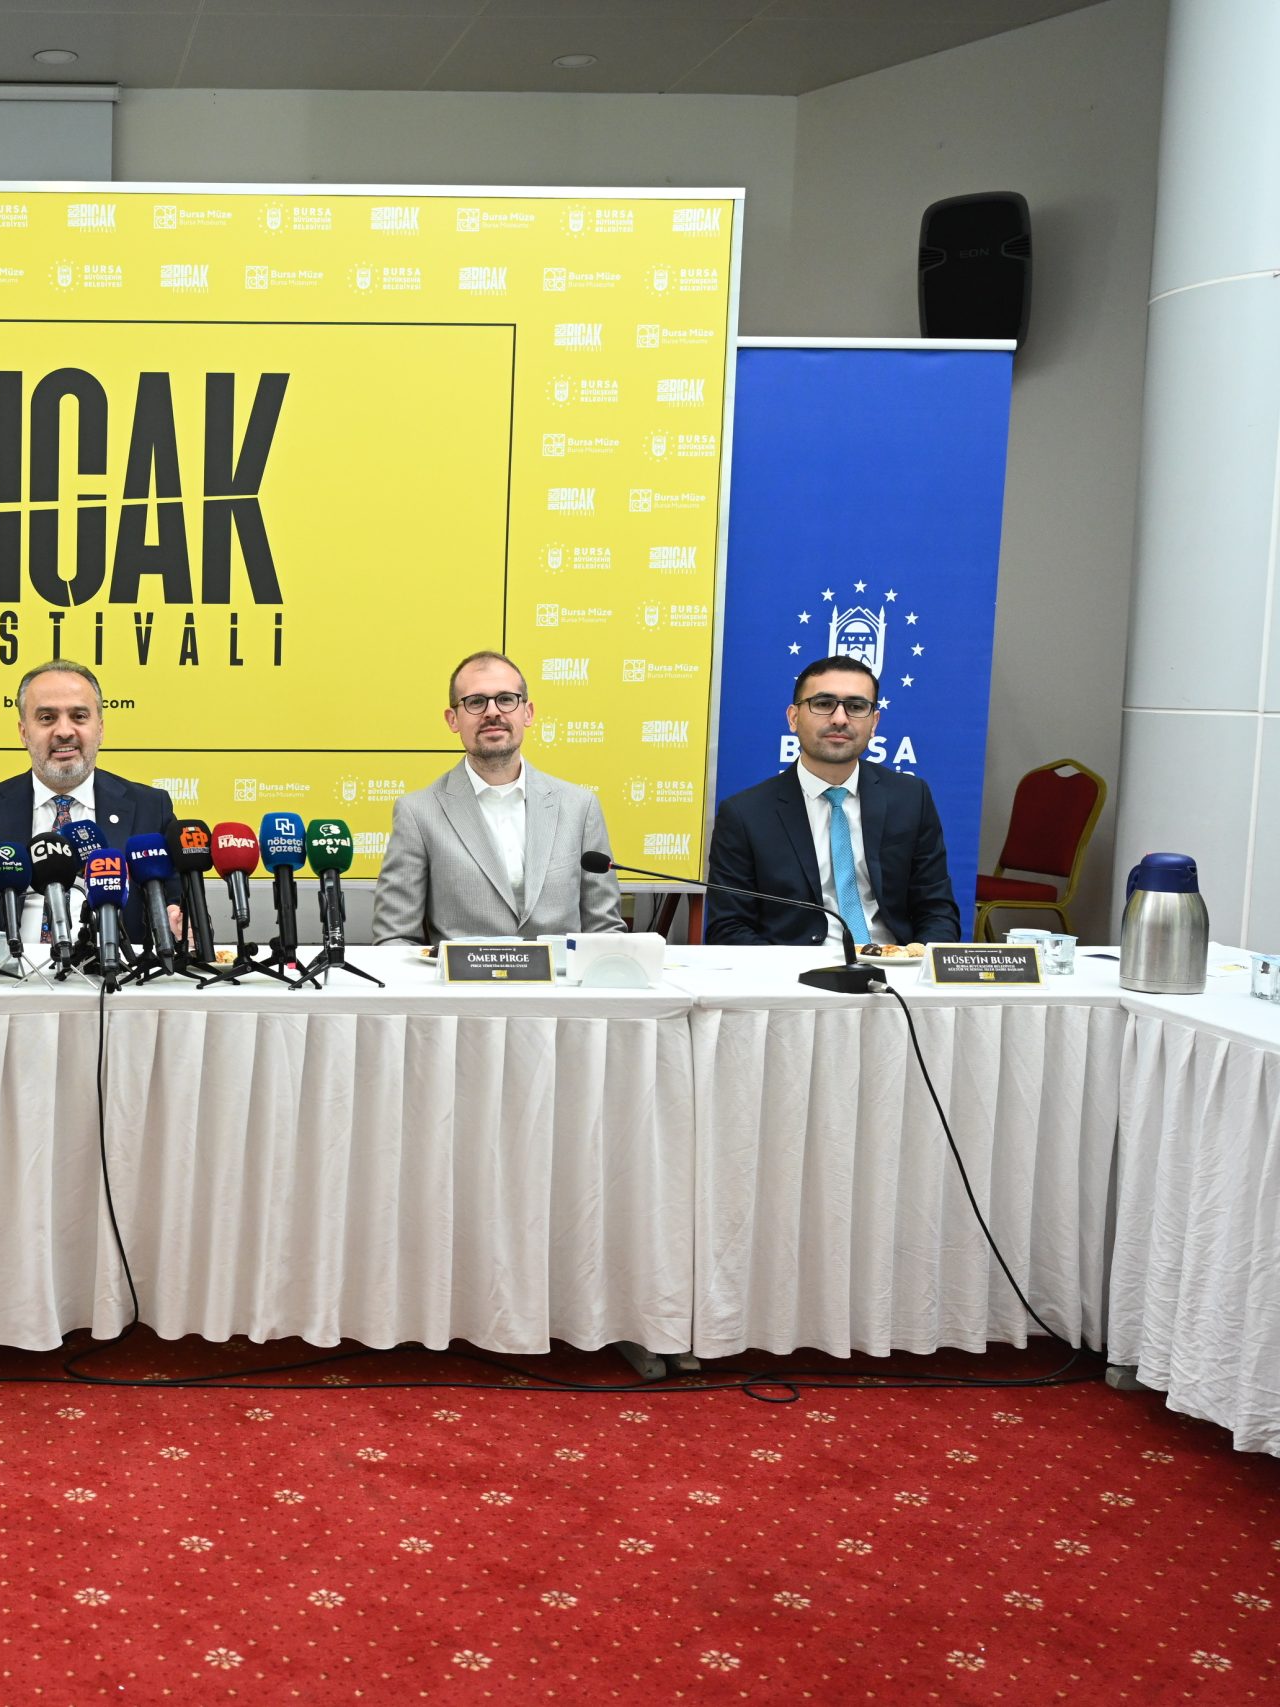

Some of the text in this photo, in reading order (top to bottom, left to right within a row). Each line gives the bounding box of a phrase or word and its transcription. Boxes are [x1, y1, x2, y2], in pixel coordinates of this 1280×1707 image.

[179, 210, 231, 218] Bursa Müze
[294, 208, 332, 216] BURSA
[596, 210, 634, 218] BURSA
[482, 213, 534, 221] Bursa Müze
[0, 267, 26, 276] Müze
[84, 265, 122, 273] BURSA
[383, 268, 420, 276] BURSA
[680, 269, 717, 277] BURSA
[271, 270, 324, 278] Bursa Müze
[568, 272, 620, 280] Bursa Müze
[661, 329, 713, 337] Bursa Müze
[581, 380, 618, 388] BURSA
[567, 438, 619, 446] Bursa Müze
[678, 435, 715, 443] BURSA
[654, 493, 706, 501] Bursa Müze
[561, 608, 613, 616] Bursa Müze
[671, 605, 708, 613] BURSA
[675, 664, 699, 672] Müze
[779, 735, 917, 764] BSA
[286, 783, 310, 791] Müze
[218, 837, 255, 848] HAYAT
[268, 837, 303, 847] nöbetçi
[78, 843, 101, 854] BURSA
[270, 845, 302, 855] gazete
[468, 953, 529, 962] ÖMER PİRGE
[943, 955, 1026, 964] HÜSEYİN BURAN
